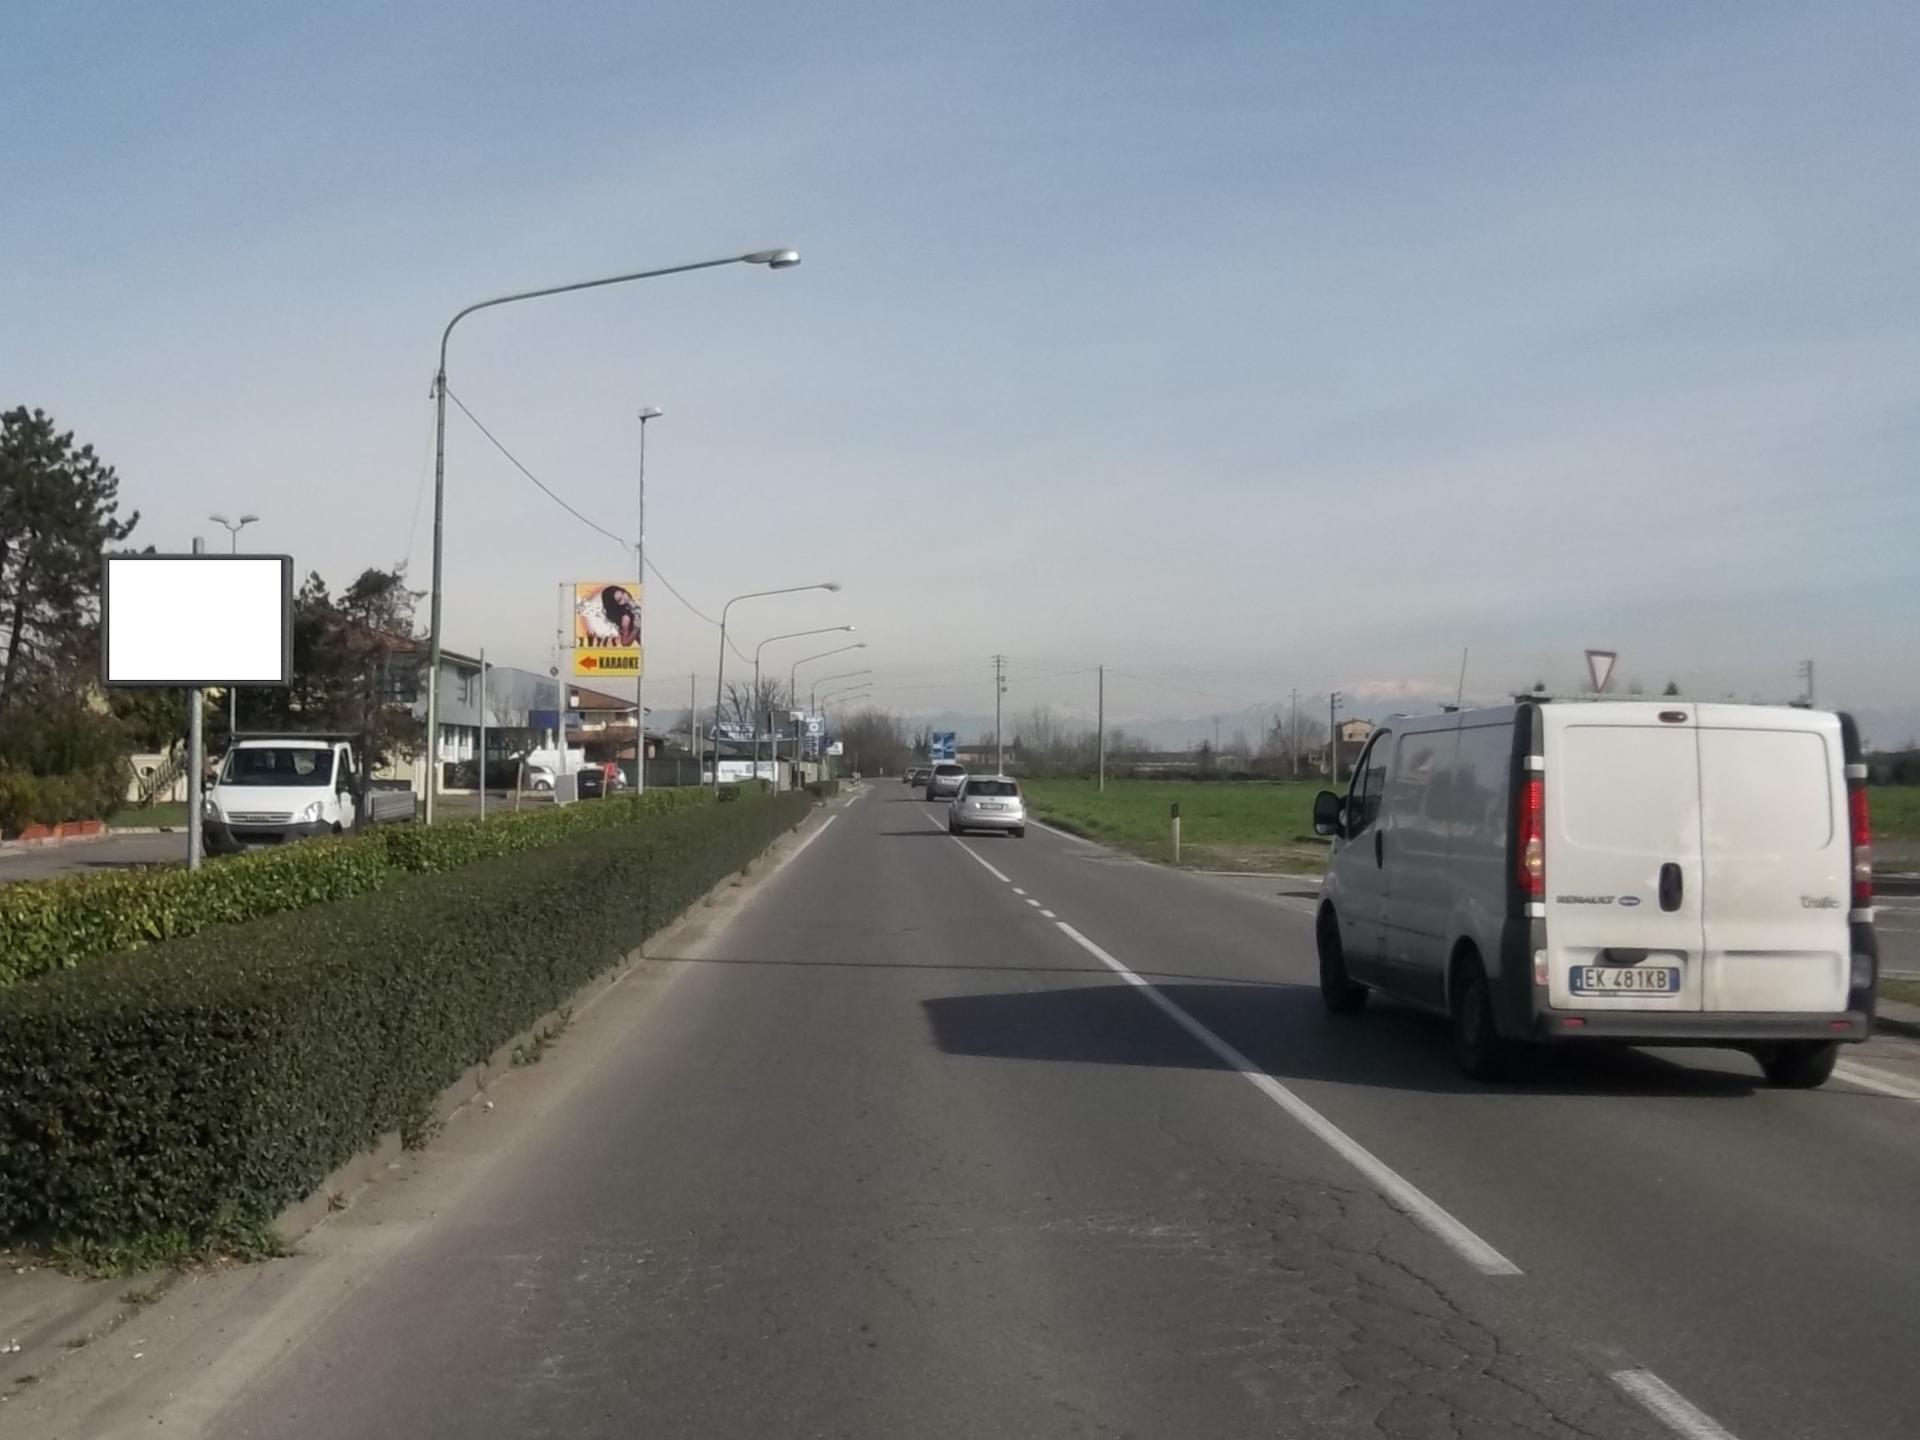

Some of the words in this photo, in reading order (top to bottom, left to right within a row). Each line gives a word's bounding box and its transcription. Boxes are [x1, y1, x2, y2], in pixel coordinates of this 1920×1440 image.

[599, 656, 639, 669] KARAOKE
[1585, 969, 1606, 987] EK
[1613, 970, 1667, 989] 481KB
